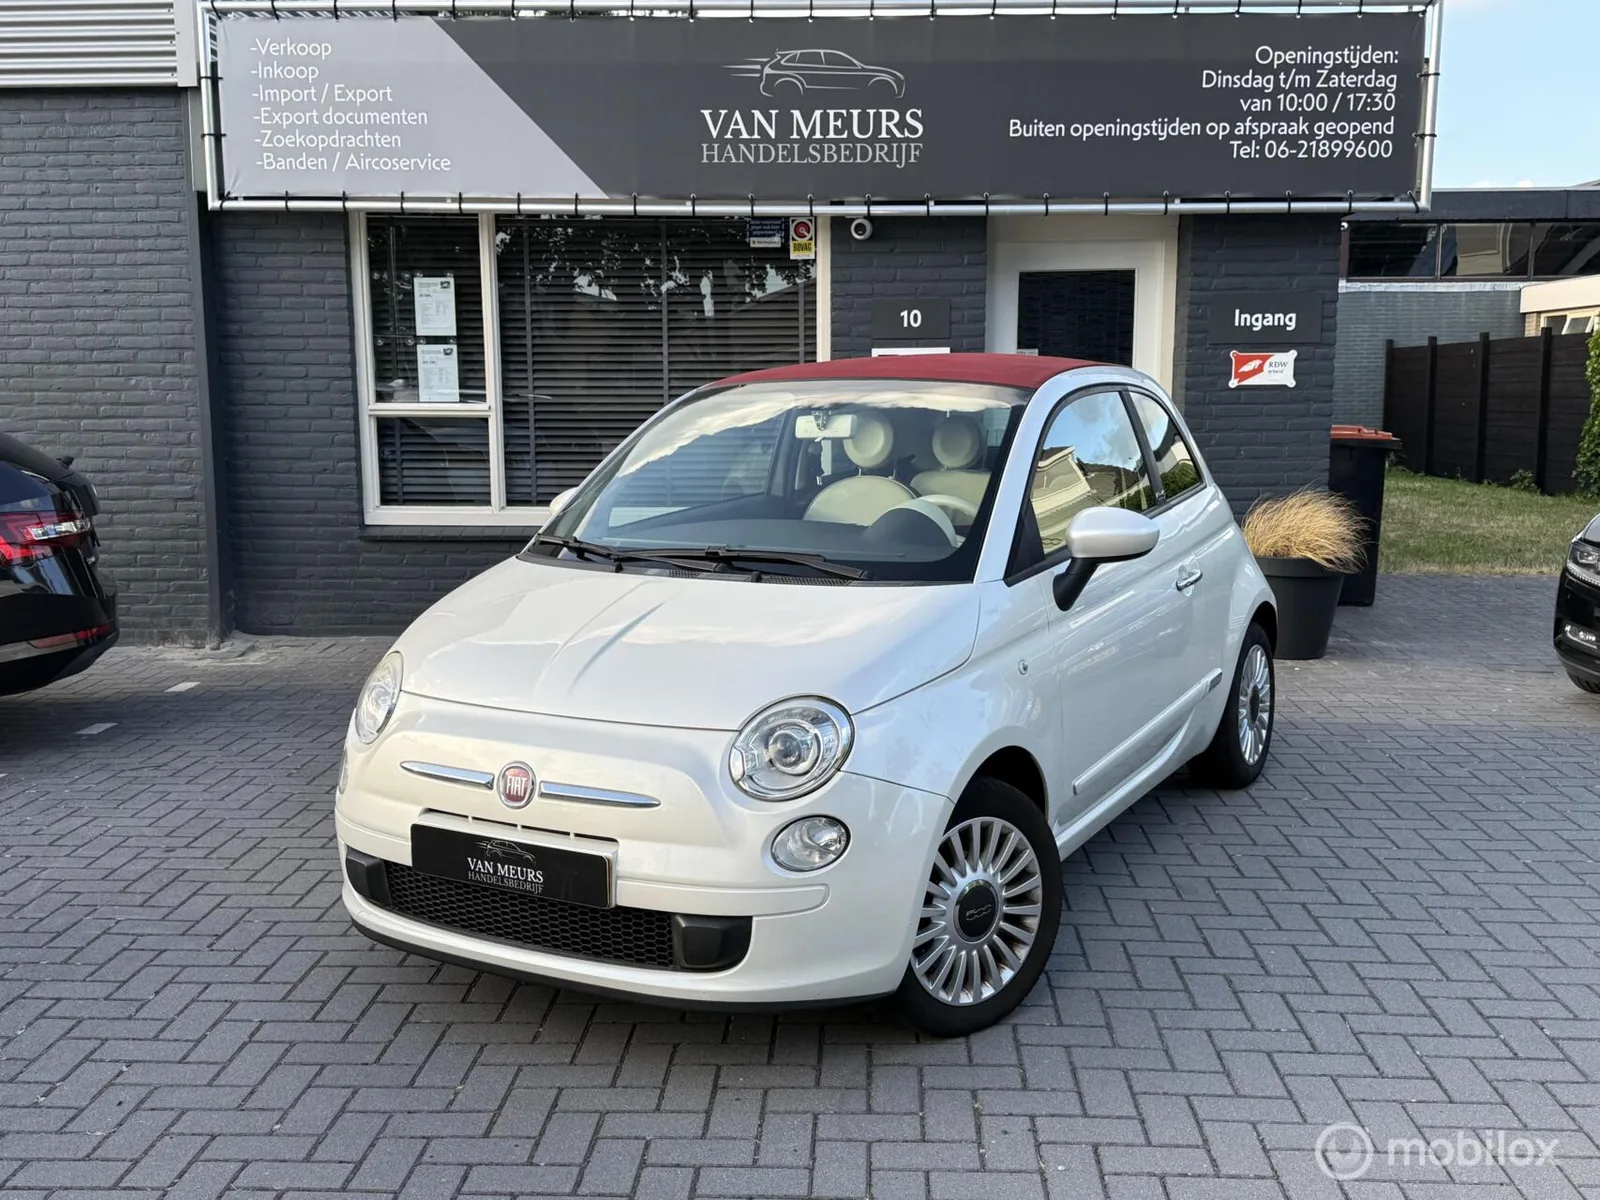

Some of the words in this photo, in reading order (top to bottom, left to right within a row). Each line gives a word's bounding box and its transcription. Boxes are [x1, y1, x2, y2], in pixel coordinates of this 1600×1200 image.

[250, 38, 332, 61] -Verkoop
[1255, 45, 1399, 69] Openingstijden:
[250, 61, 319, 82] -Inkoop
[1202, 69, 1274, 92] Dinsdag
[1278, 70, 1311, 89] t/m
[1315, 69, 1398, 92] Zaterdag
[252, 84, 317, 106] -Import
[334, 84, 392, 106] Export
[1240, 97, 1272, 112] van
[1276, 94, 1328, 112] 10:00
[1346, 93, 1396, 112] 17:30
[253, 108, 319, 129] -Export
[322, 107, 428, 125] documenten
[700, 109, 779, 139] VAN
[789, 108, 924, 139] MEURS
[1009, 119, 1065, 138] Buiten
[1069, 118, 1201, 141] openingstijden
[1205, 123, 1230, 140] op
[1234, 117, 1309, 140] afspraak
[1314, 117, 1394, 140] geopend
[254, 130, 401, 152] -Zoekopdrachten
[1229, 140, 1260, 159] Tel:
[1264, 140, 1393, 159] 06-21899600
[256, 153, 327, 171] -Banden
[345, 153, 451, 172] Aircoservice
[701, 143, 924, 169] HANDELSBEDRIJF
[793, 242, 812, 252] BOVAG
[900, 309, 922, 328] 10
[1234, 309, 1297, 331] Ingang
[1268, 361, 1288, 369] RDW
[506, 776, 528, 796] FIAT
[467, 857, 492, 873] VAN
[497, 863, 544, 883] MEURS
[468, 871, 544, 894] HANDELSBEDRIJF
